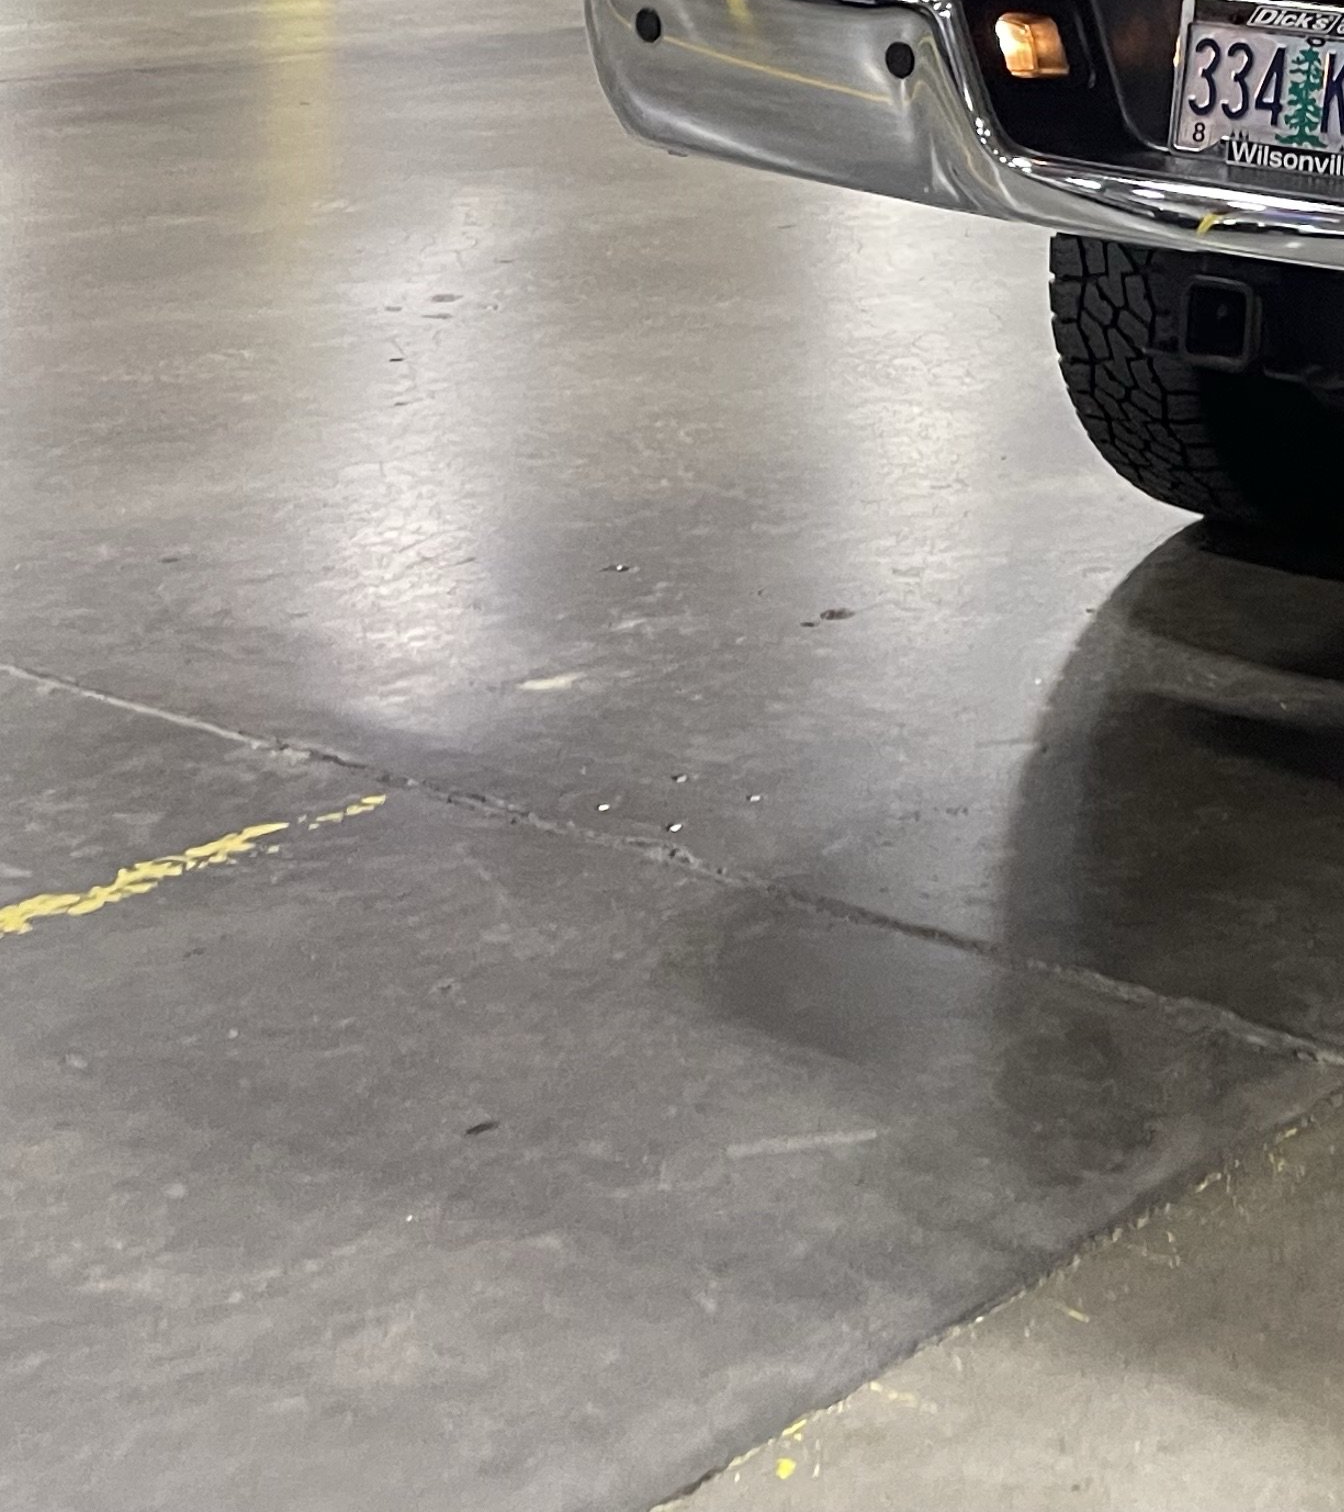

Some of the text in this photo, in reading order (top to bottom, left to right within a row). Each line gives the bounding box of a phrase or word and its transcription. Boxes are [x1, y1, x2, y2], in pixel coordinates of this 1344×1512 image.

[1253, 7, 1331, 32] Dick's
[1188, 37, 1288, 127] 334
[1192, 121, 1207, 143] 8
